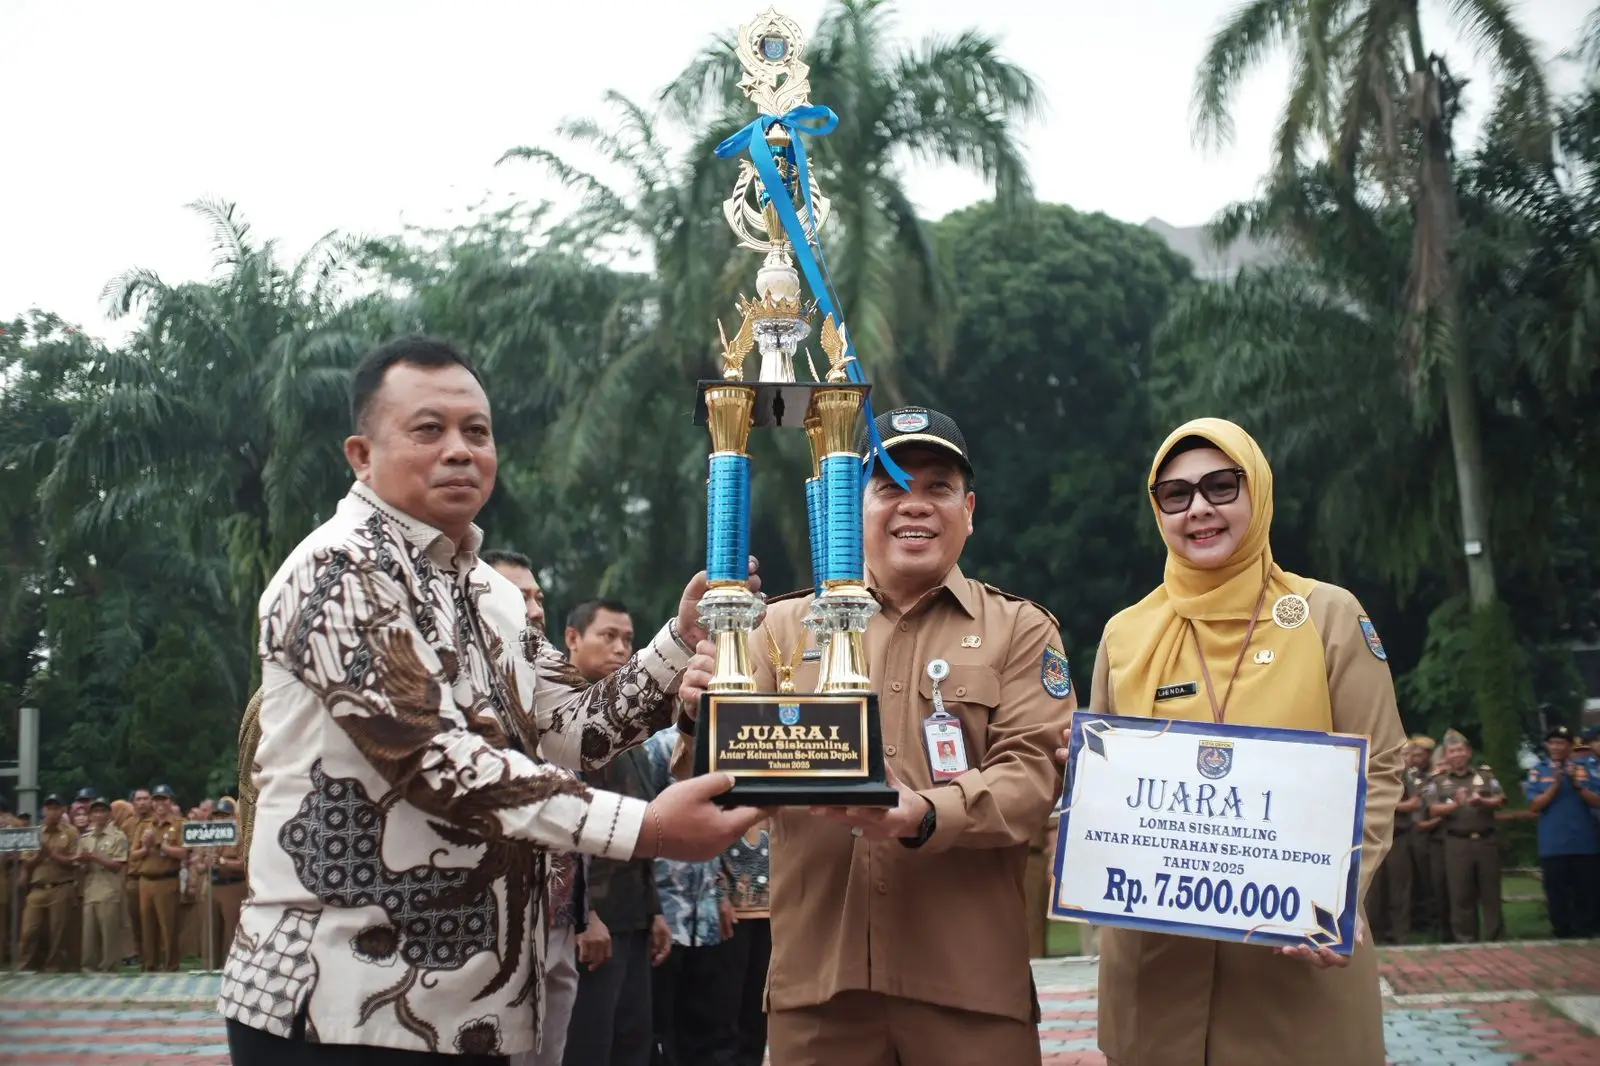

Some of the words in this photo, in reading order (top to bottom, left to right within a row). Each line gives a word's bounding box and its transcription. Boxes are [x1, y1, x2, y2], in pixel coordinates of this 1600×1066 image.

[737, 725, 824, 740] JUARA
[828, 726, 840, 740] I
[729, 740, 774, 750] Lomba
[776, 740, 849, 751] Siskamling
[719, 751, 746, 760] Antar
[747, 750, 794, 760] Kelurahan
[794, 751, 829, 760] Se-Kota
[830, 750, 858, 762] Depok
[768, 761, 791, 769] Tahun
[791, 761, 810, 769] 2025
[1126, 777, 1244, 818] JUARA
[1261, 790, 1273, 823] 1
[1139, 817, 1187, 832] LOMBA
[1188, 822, 1277, 841] SISKAMLING
[1084, 830, 1130, 845] ANTAR
[1132, 834, 1218, 854] KELURAHAN
[1221, 844, 1279, 861] SE-KOTA
[1282, 850, 1331, 865] DEPOK
[1163, 856, 1211, 872] TAHUN
[1212, 860, 1245, 875] 2025
[1103, 867, 1147, 913] Rp.
[1154, 872, 1300, 922] 7.500.000
